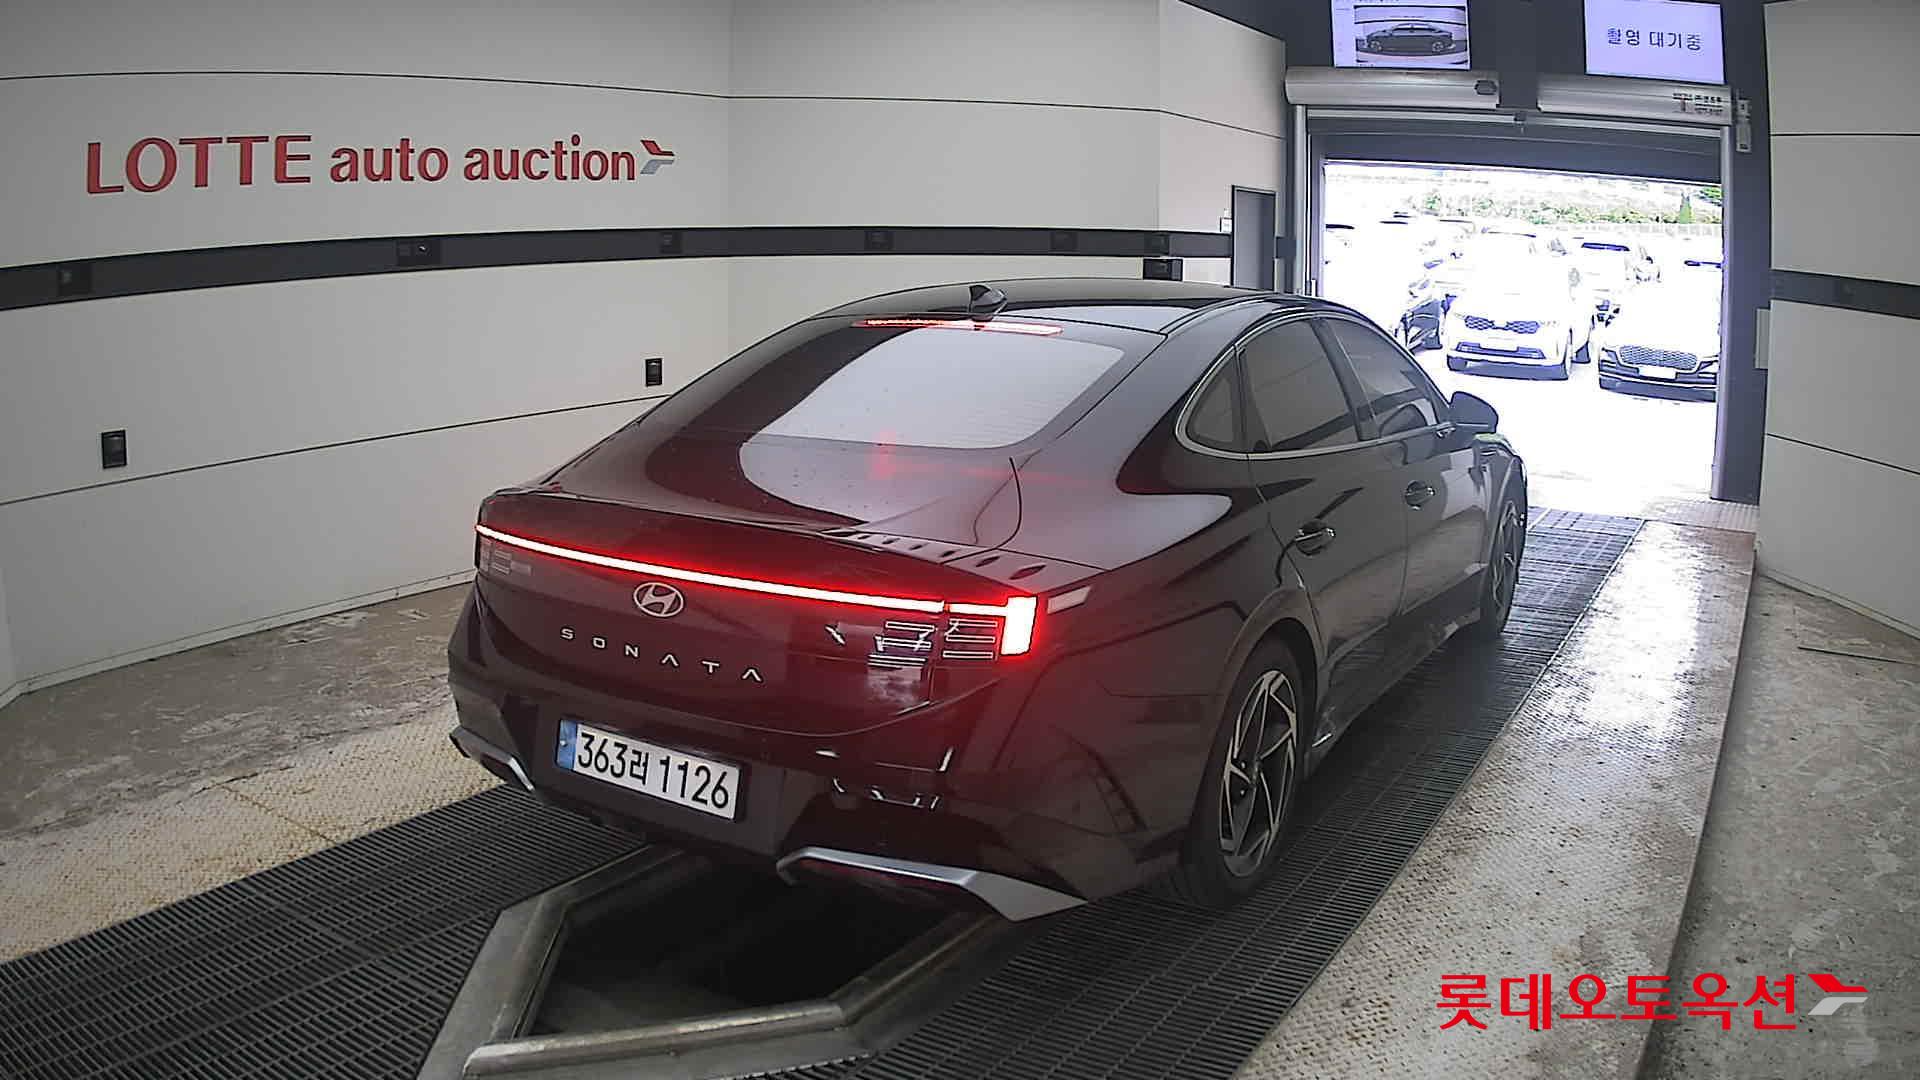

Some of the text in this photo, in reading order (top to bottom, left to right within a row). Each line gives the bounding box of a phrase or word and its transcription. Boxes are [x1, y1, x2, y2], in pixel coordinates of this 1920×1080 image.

[86, 133, 636, 194] LOTTE auto auction
[560, 627, 763, 683] SONATA
[578, 732, 729, 809] 363러 1126
